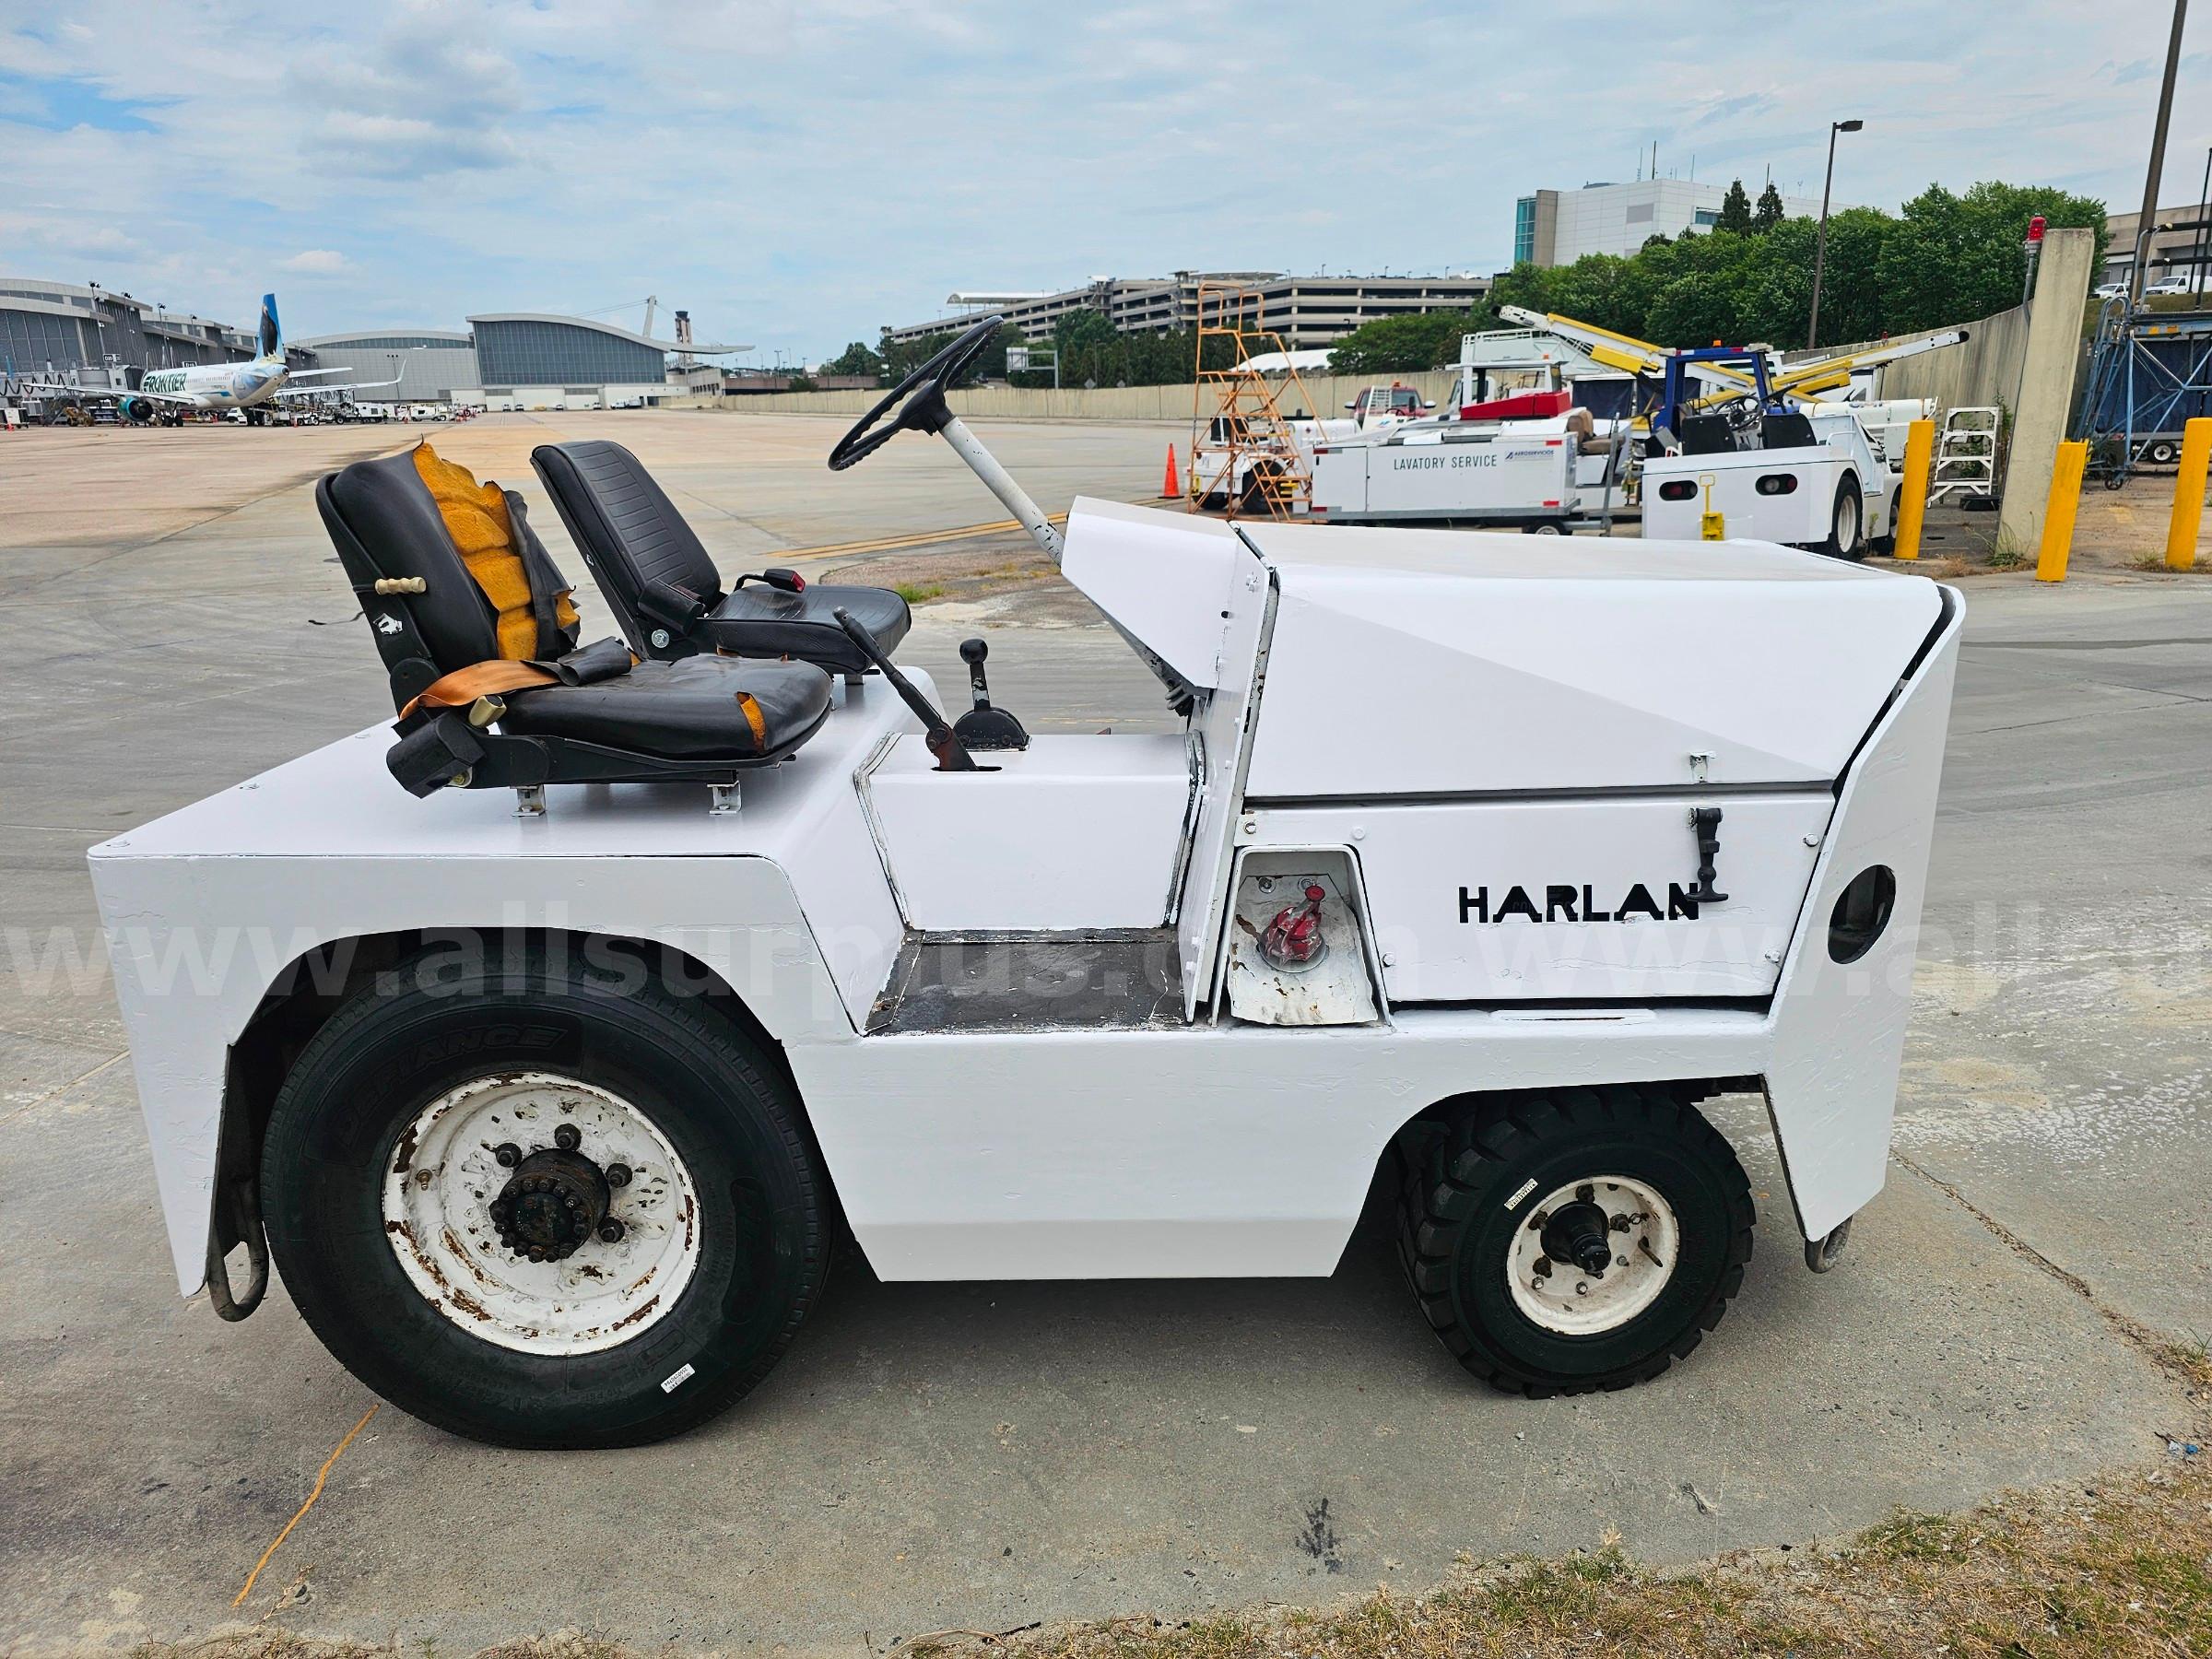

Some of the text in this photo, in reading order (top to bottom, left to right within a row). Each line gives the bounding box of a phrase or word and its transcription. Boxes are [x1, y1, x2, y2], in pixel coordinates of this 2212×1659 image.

[143, 372, 187, 393] FRONTIER
[1394, 454, 1498, 470] LAVATORY SERVICE
[1459, 883, 1699, 923] HARLAN
